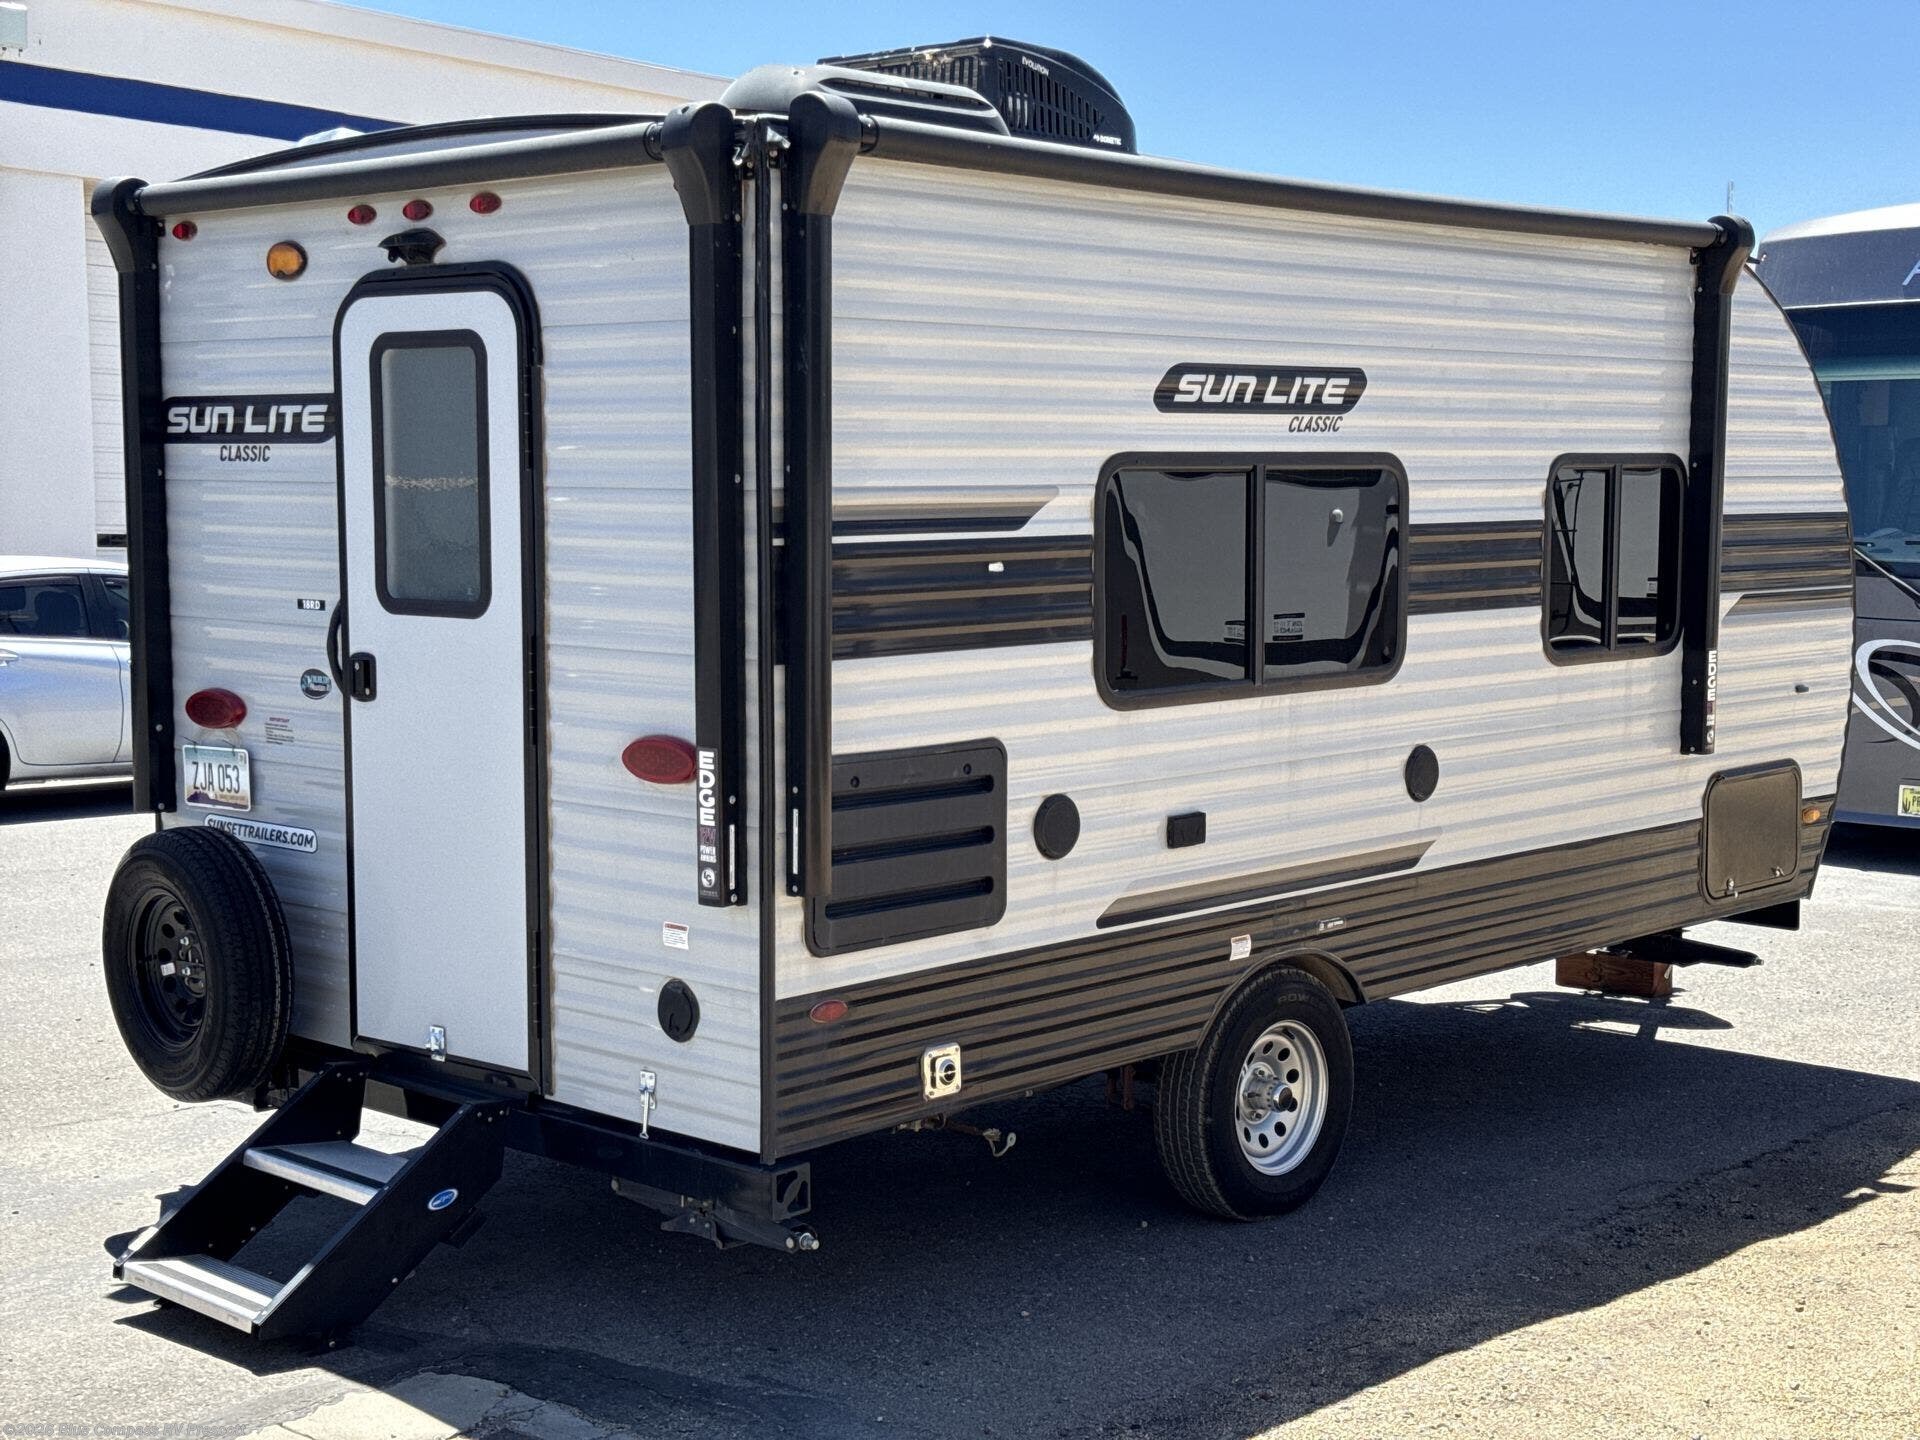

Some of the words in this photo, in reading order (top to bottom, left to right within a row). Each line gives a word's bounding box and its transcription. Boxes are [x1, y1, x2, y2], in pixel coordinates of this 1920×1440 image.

[1173, 373, 1258, 404] SUN
[1263, 375, 1350, 405] LITE
[167, 405, 235, 434] SUN
[243, 404, 329, 434] LITE
[1288, 415, 1344, 433] CLASSIC
[220, 445, 271, 463] CLASSIC
[302, 599, 321, 610] 18RD
[1707, 650, 1717, 702] EDGE
[191, 761, 215, 792] ZJA
[217, 763, 241, 794] 053
[699, 750, 716, 827] EDGE
[207, 818, 315, 848] SUNSETTRAILERS.COM
